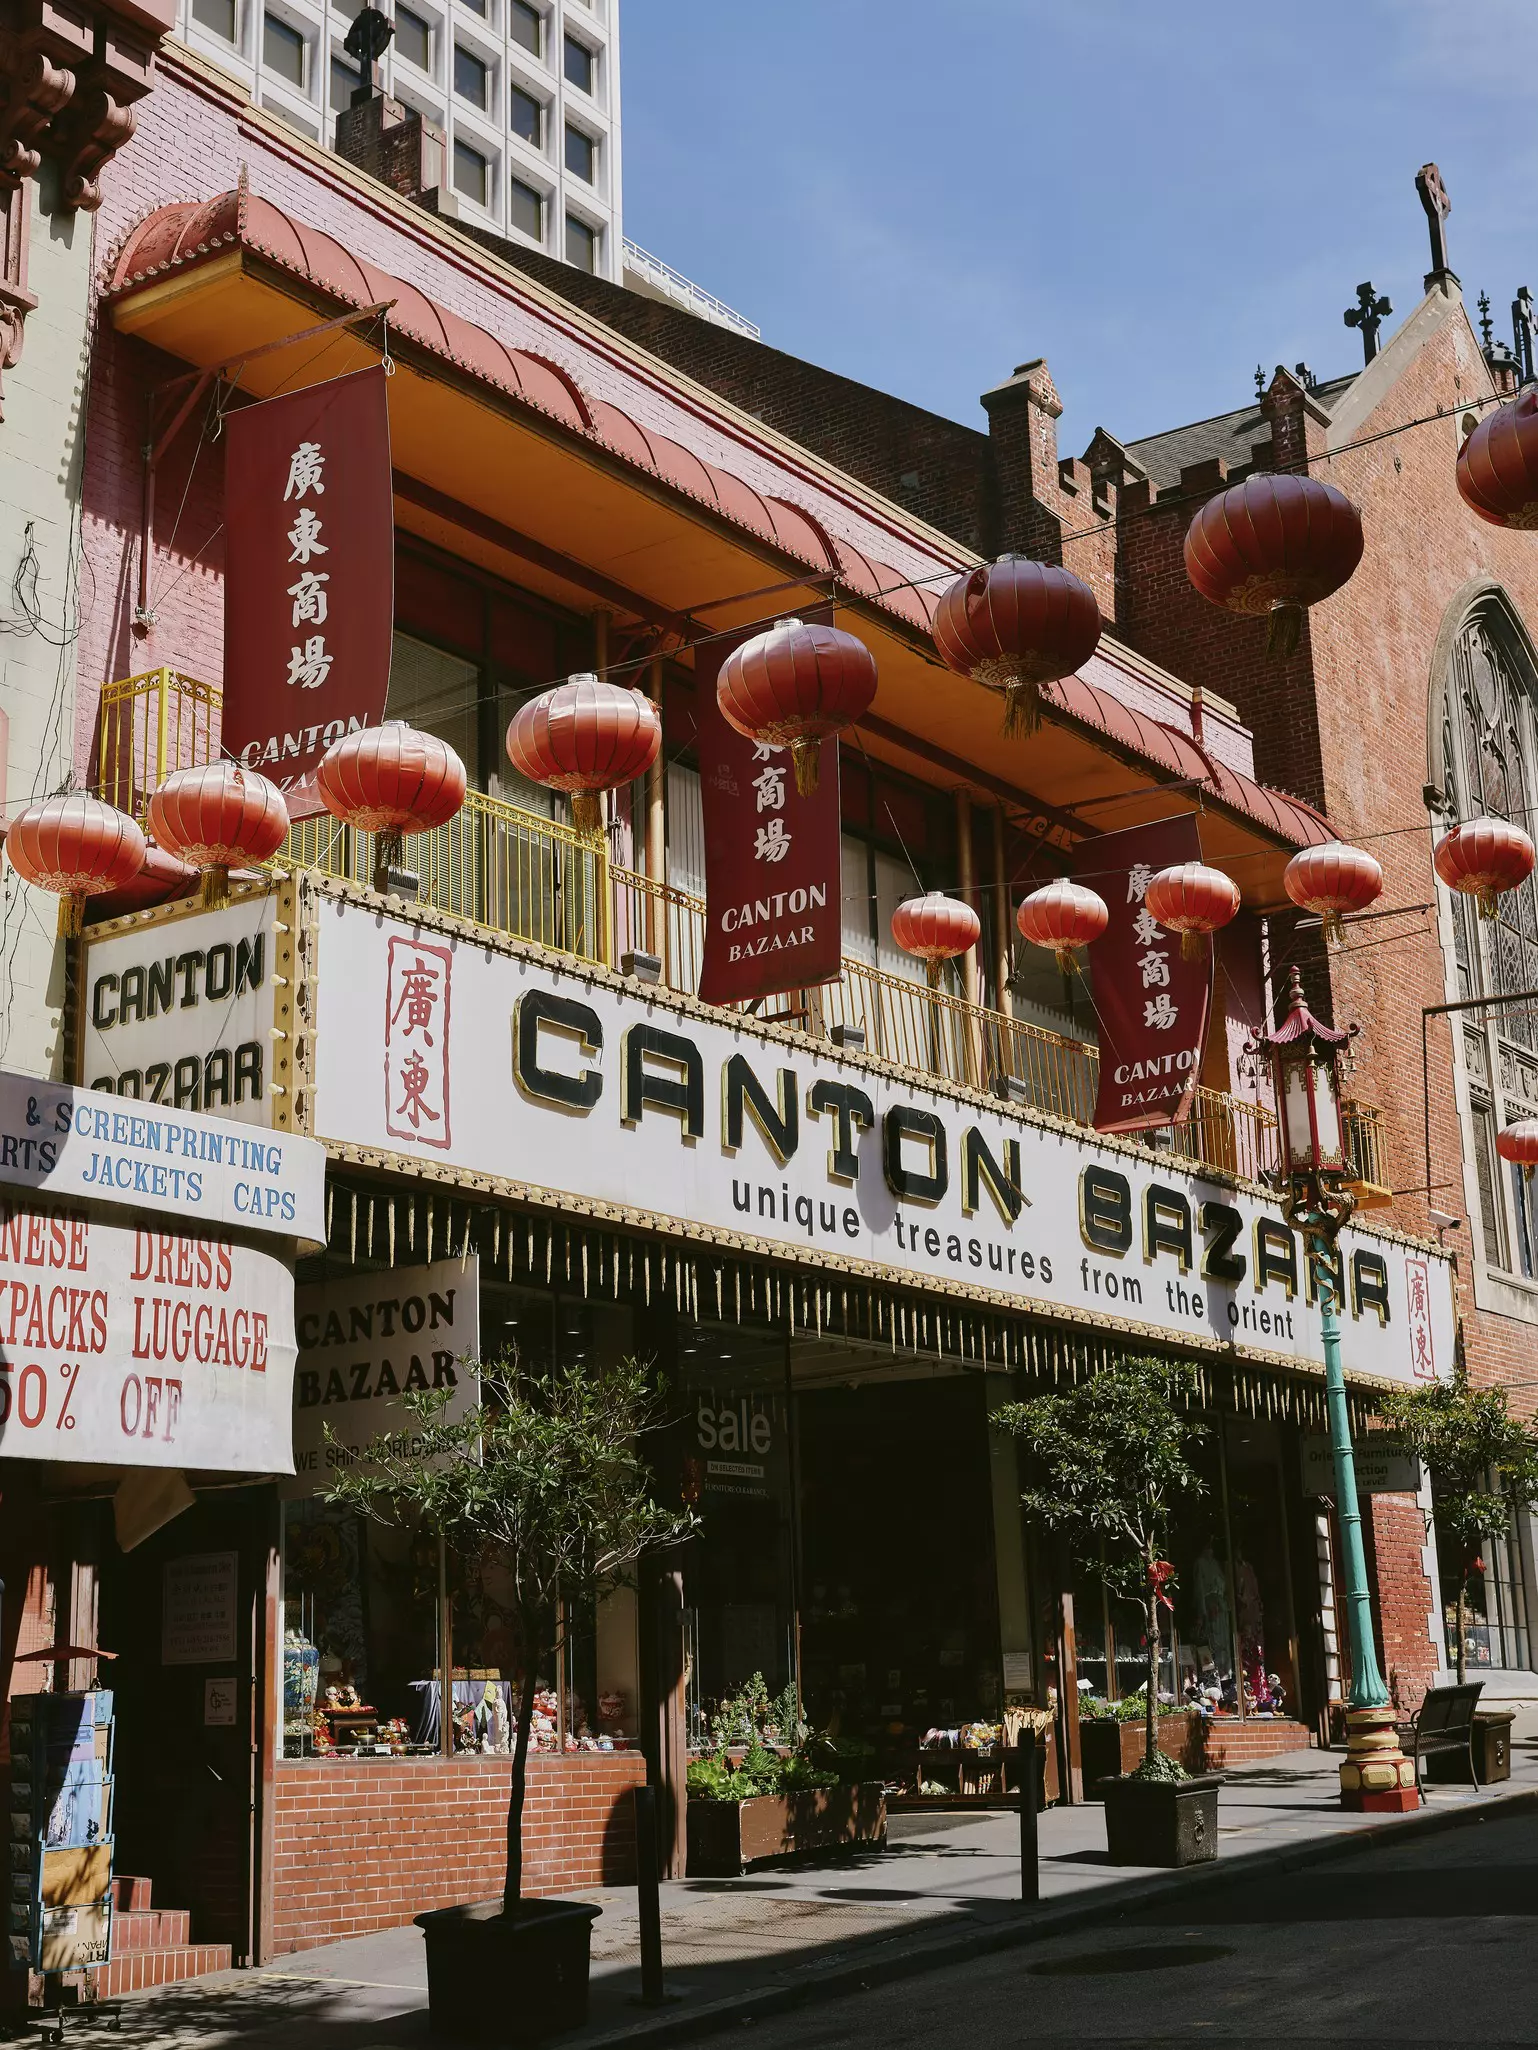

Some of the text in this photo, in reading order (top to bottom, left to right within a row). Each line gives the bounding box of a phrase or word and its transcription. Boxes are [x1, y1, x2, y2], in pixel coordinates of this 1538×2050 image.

[283, 441, 334, 690] 廣東商場
[720, 882, 828, 934] CANTON
[728, 925, 816, 963] BAZAAR
[92, 932, 266, 1031] CANTON
[391, 957, 441, 1129] 廣東
[512, 988, 1026, 1223] CANTON
[1121, 1077, 1194, 1107] BAZAAR
[26, 1096, 282, 1176] & SCREENPRINTING
[82, 1152, 203, 1202] JACKETS
[233, 1182, 296, 1221] CAPS
[130, 1218, 233, 1293] DRESS
[732, 1178, 1295, 1341] unique treasures from the orient
[132, 1296, 269, 1373] LUGGAGE
[298, 1288, 457, 1350] CANTON
[1410, 1270, 1432, 1371] 廣東
[120, 1372, 183, 1444] OFF
[298, 1350, 459, 1408] BAZAAR
[697, 1398, 772, 1454] sale
